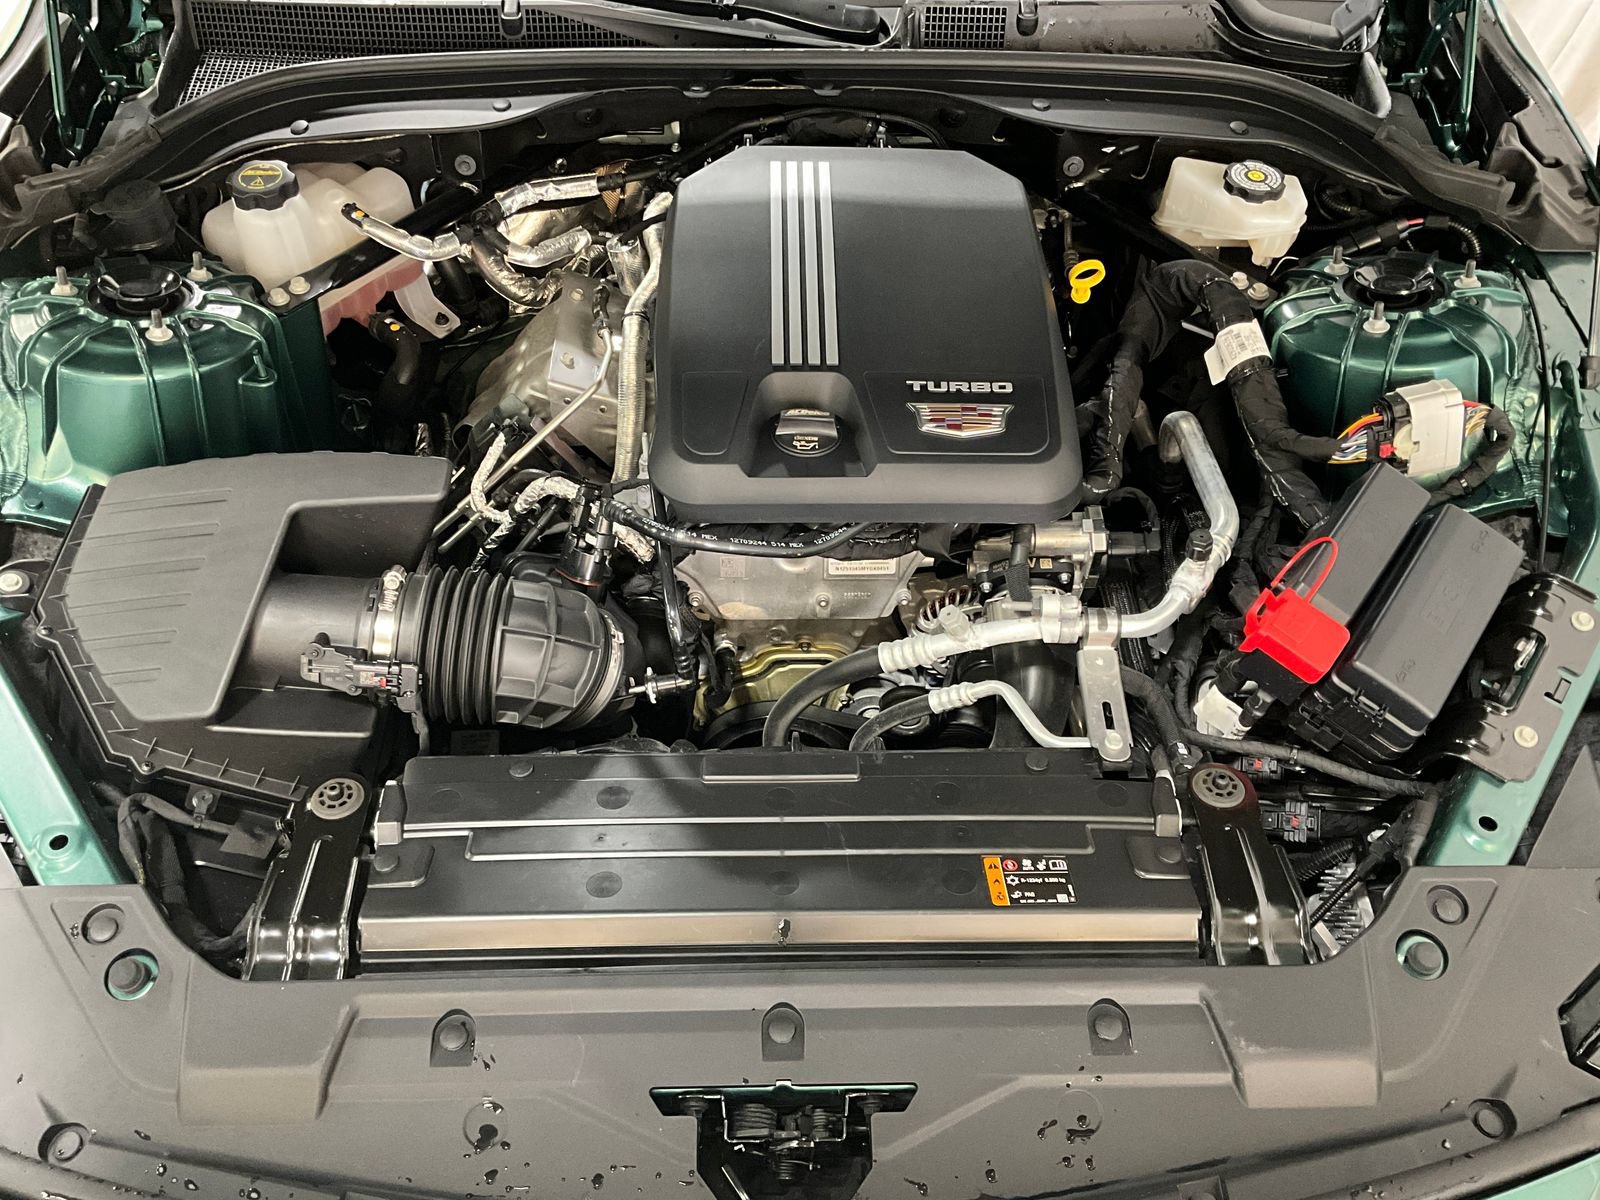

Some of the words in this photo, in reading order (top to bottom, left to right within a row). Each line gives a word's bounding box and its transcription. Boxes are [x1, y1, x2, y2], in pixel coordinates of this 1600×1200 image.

[905, 380, 1013, 393] TURBO
[701, 533, 718, 541] MEX
[729, 537, 767, 546] 12709244
